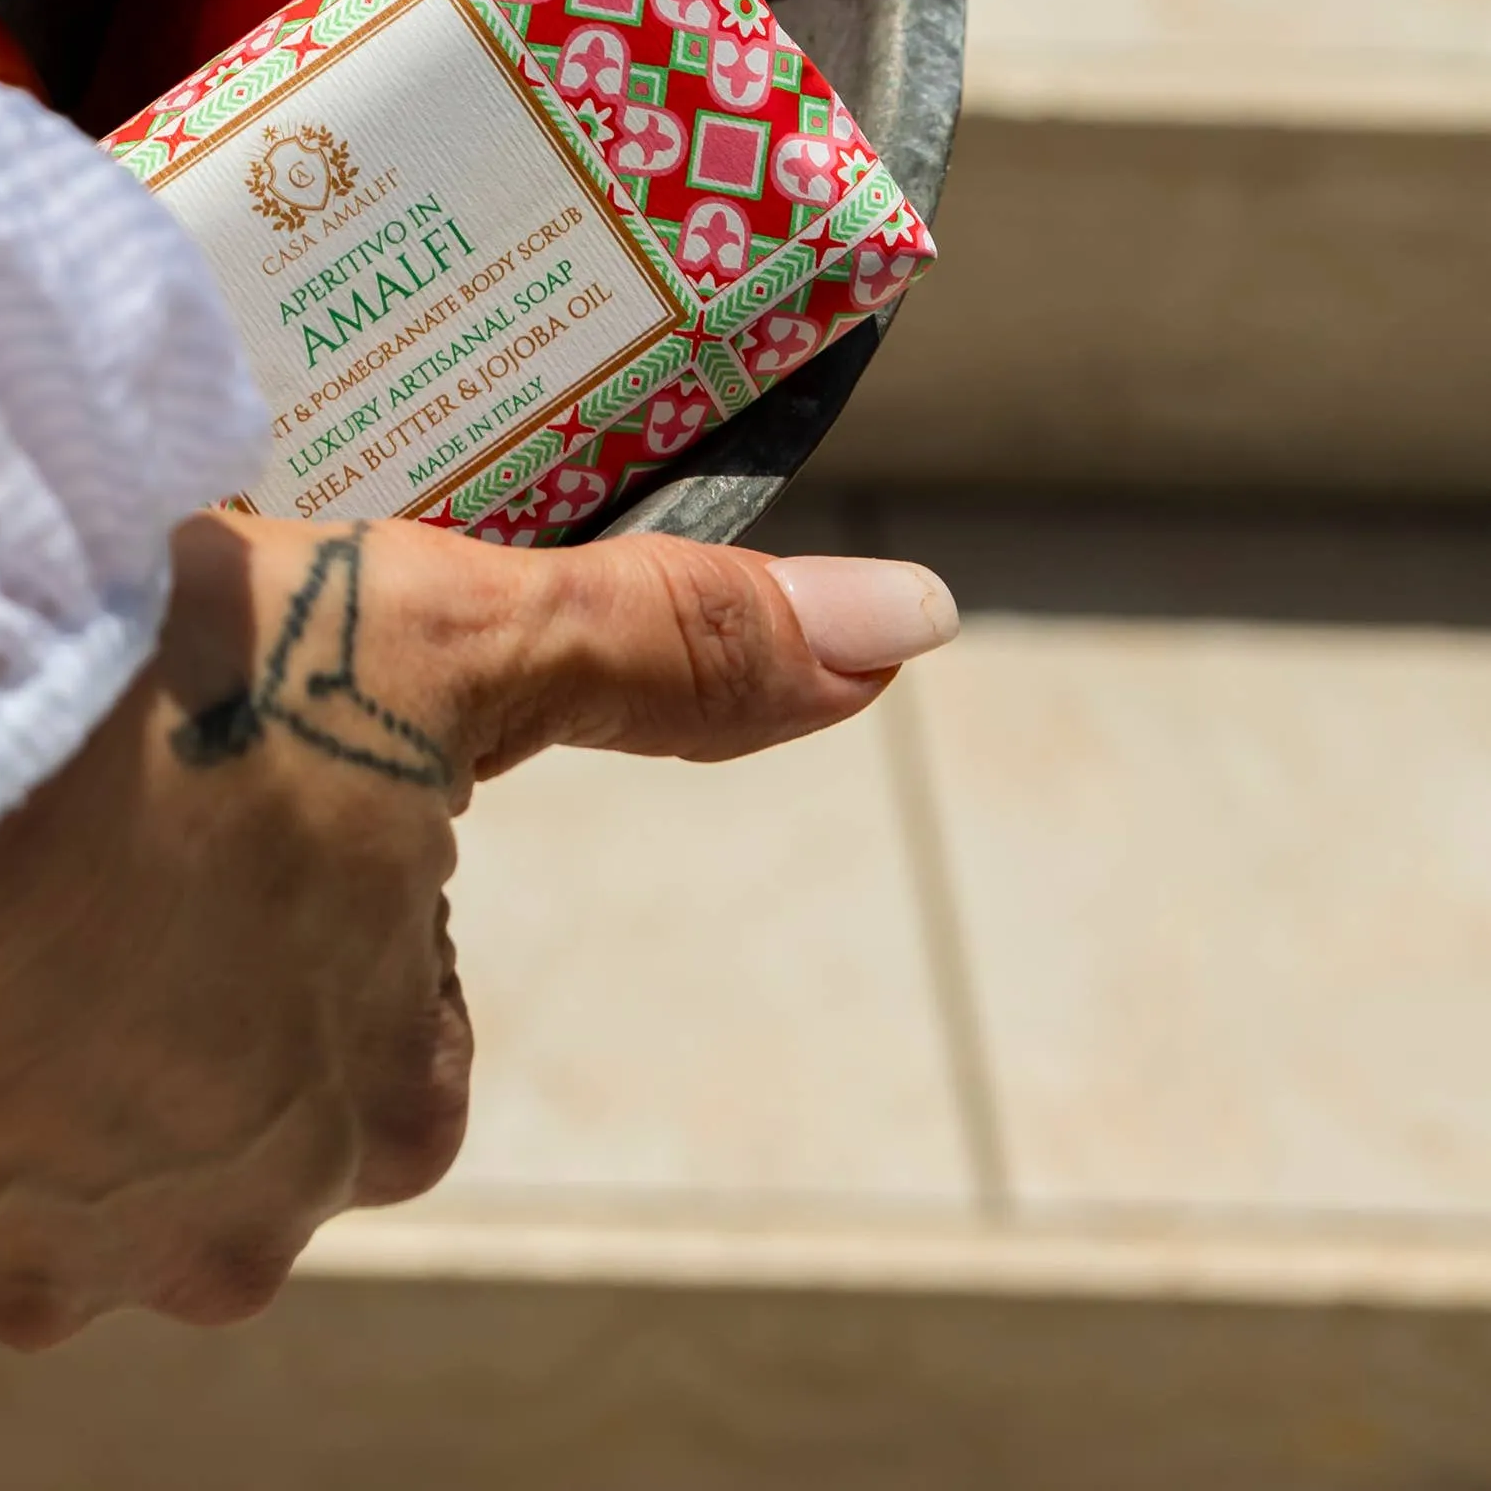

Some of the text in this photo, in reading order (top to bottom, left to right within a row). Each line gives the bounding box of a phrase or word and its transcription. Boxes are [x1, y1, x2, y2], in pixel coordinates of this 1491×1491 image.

[262, 234, 318, 277] CASA
[278, 192, 444, 326] APERITIVO IN
[294, 403, 315, 423] &
[310, 294, 461, 403] POMEGRANATE
[458, 250, 516, 304] BODY
[516, 205, 584, 262] SCRUB
[299, 217, 476, 369] AMALFI
[286, 258, 574, 478] LUXURY ARTISANAL SOAP
[294, 281, 613, 519] SHEA BUTTER & JOJOBA OIL
[406, 375, 547, 489] MADE IN ITALY
